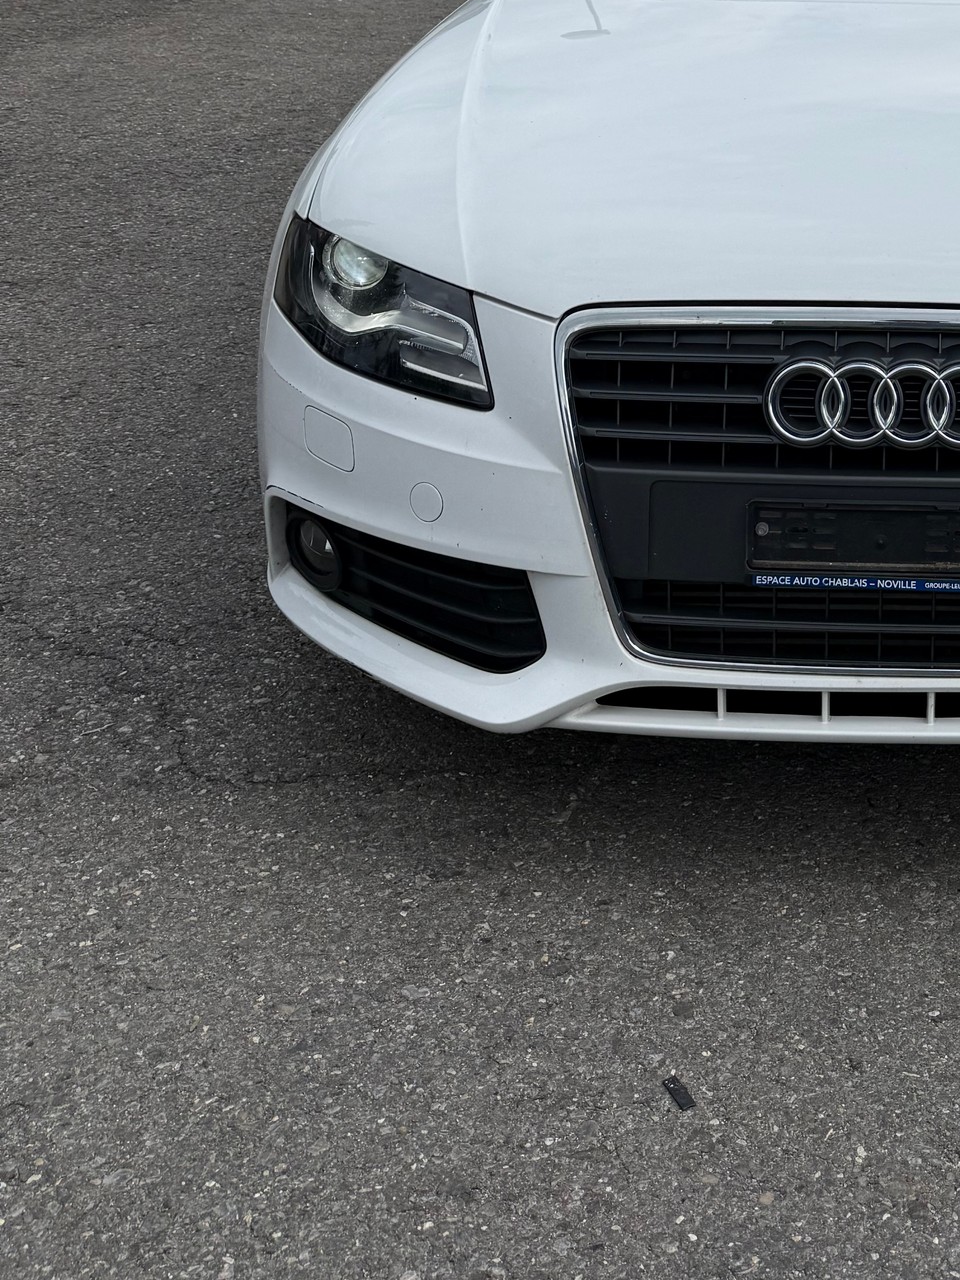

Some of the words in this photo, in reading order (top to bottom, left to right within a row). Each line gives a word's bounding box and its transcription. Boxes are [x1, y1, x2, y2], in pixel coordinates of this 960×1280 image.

[755, 575, 791, 585] ESPACE
[793, 576, 820, 586] AUTO
[822, 577, 868, 588] CHABLAIS
[877, 579, 917, 589] NOVILLE
